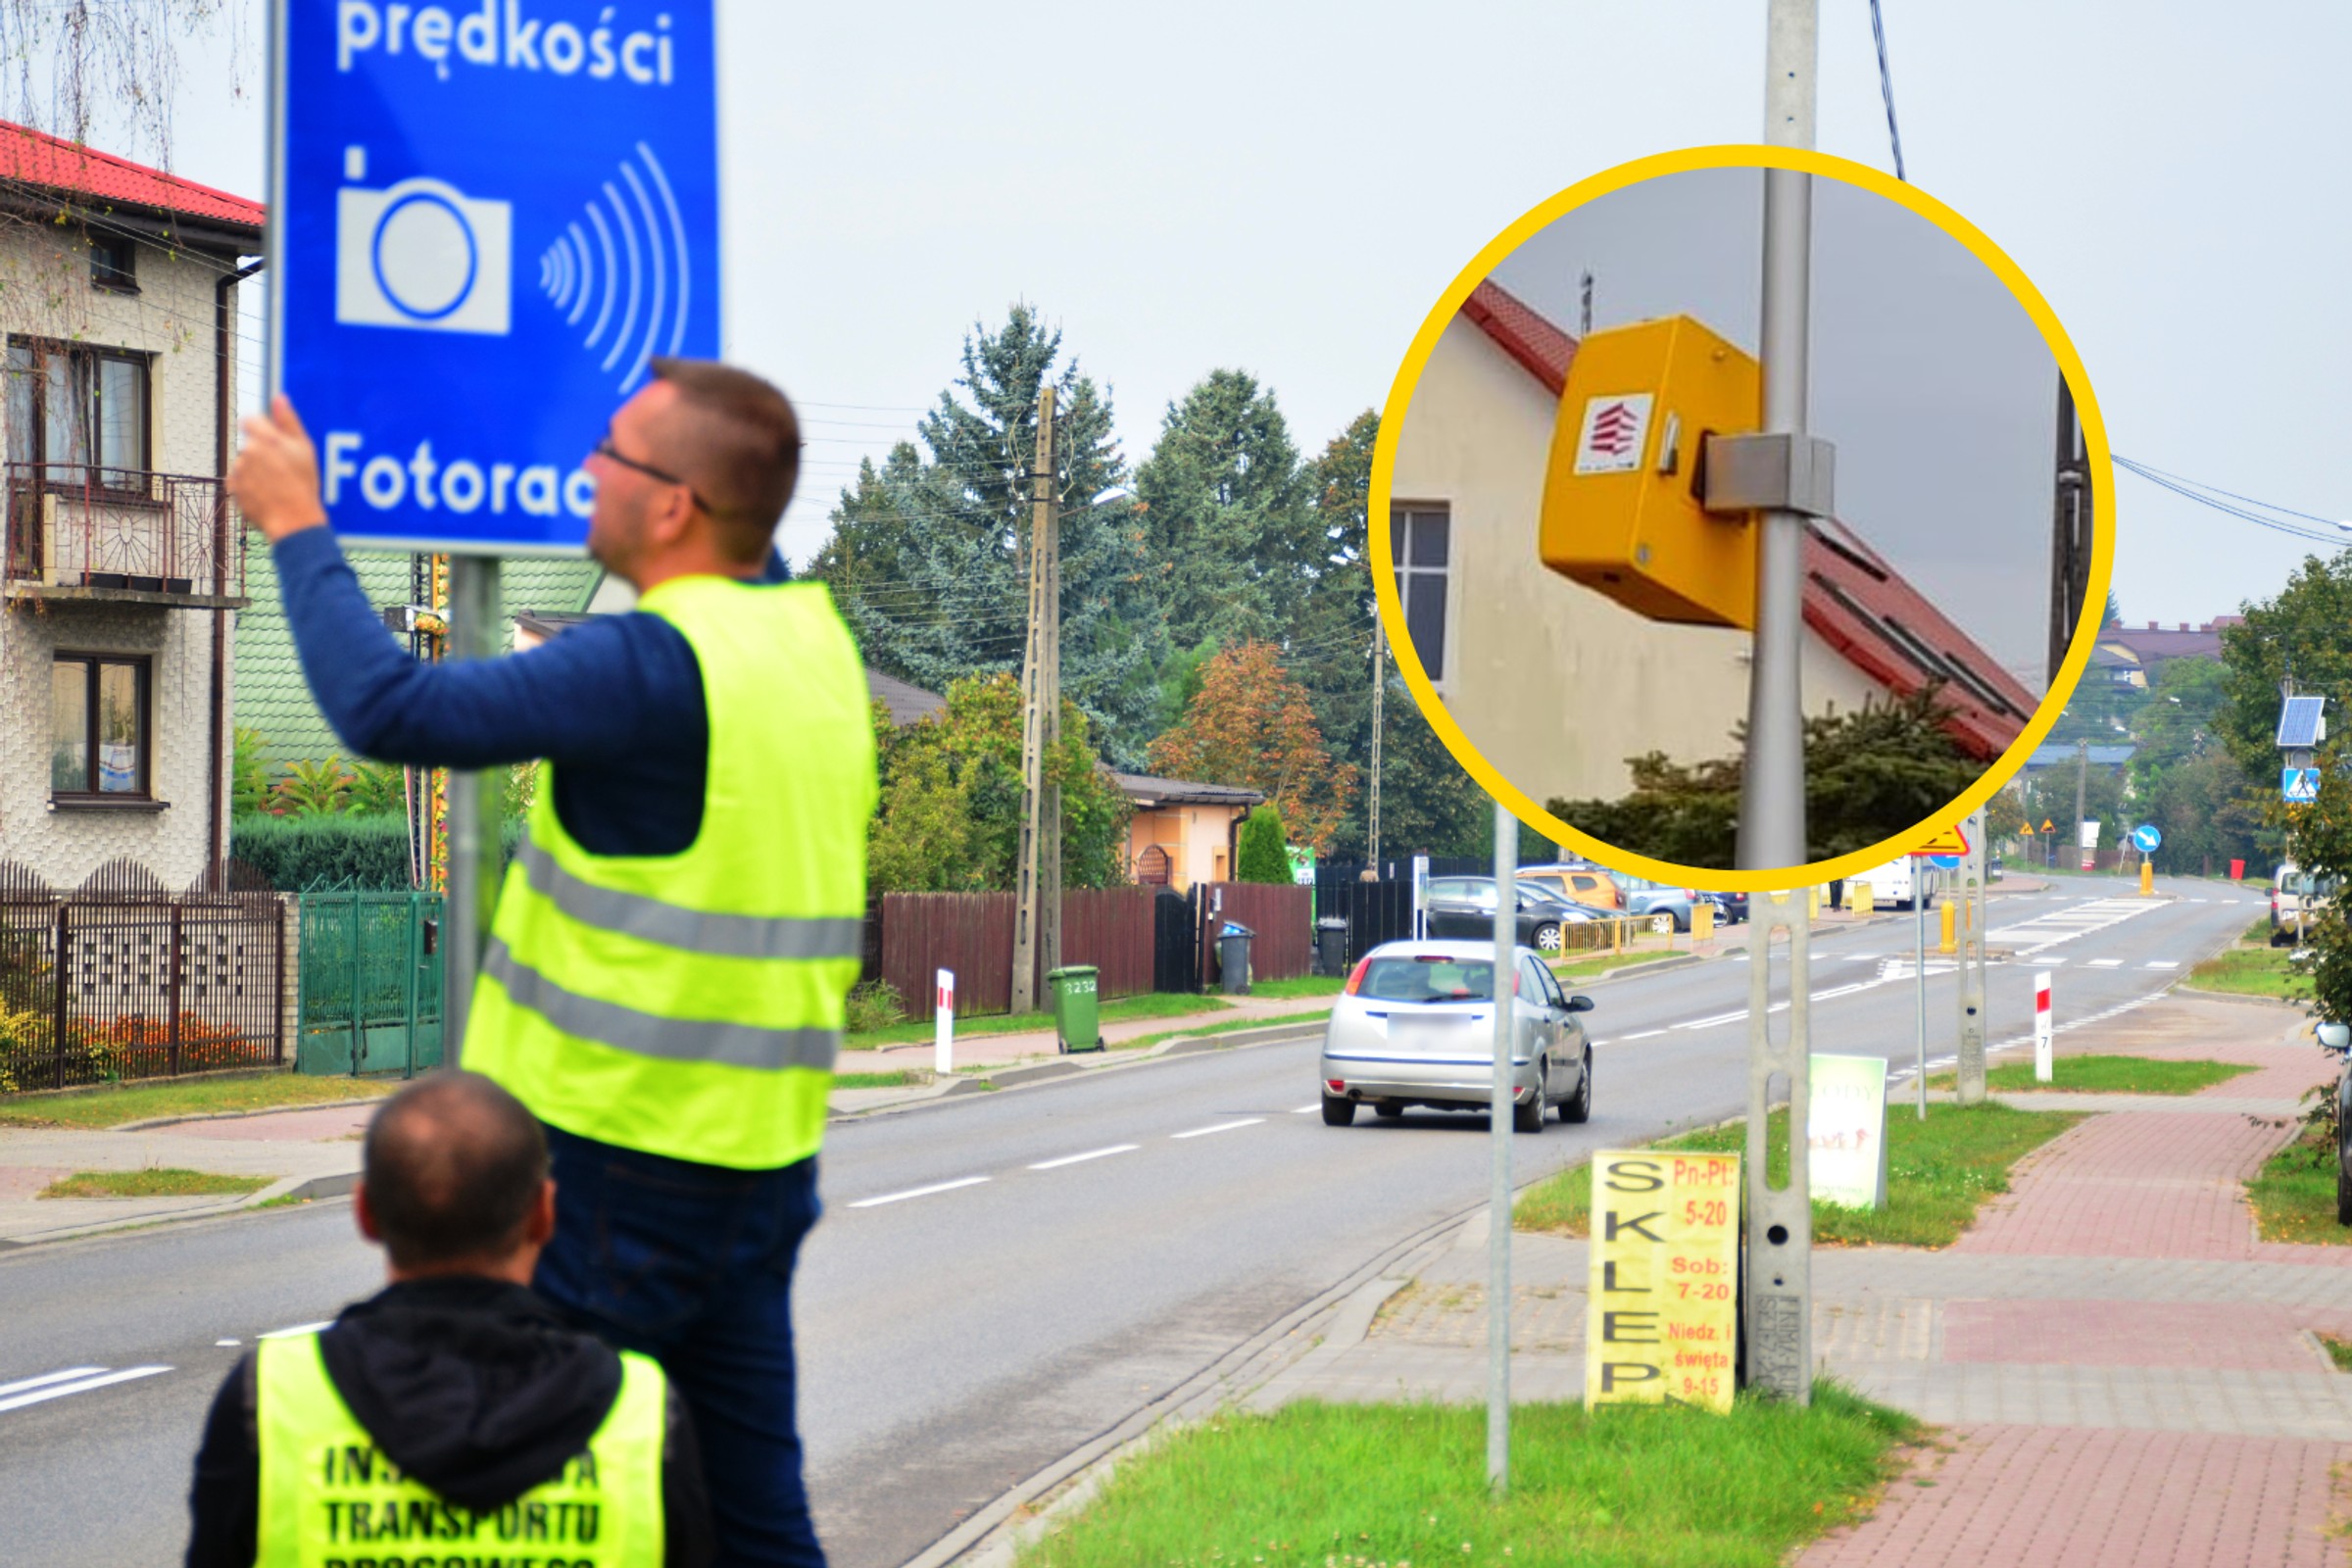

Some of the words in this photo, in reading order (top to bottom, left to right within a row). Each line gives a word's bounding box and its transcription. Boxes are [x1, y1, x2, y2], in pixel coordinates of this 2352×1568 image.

[336, 0, 673, 82] prędkości
[1064, 980, 1097, 996] 3232
[1674, 1159, 1734, 1187] Pn-Pt:
[1686, 1200, 1727, 1226] 5-20
[1672, 1257, 1728, 1274] Sob:
[1600, 1161, 1666, 1394] SKLEP
[1678, 1283, 1730, 1300] 7-20
[1668, 1323, 1721, 1341] Niedz.
[1726, 1323, 1731, 1342] i
[1675, 1348, 1728, 1372] święta
[1684, 1377, 1719, 1396] 9-15
